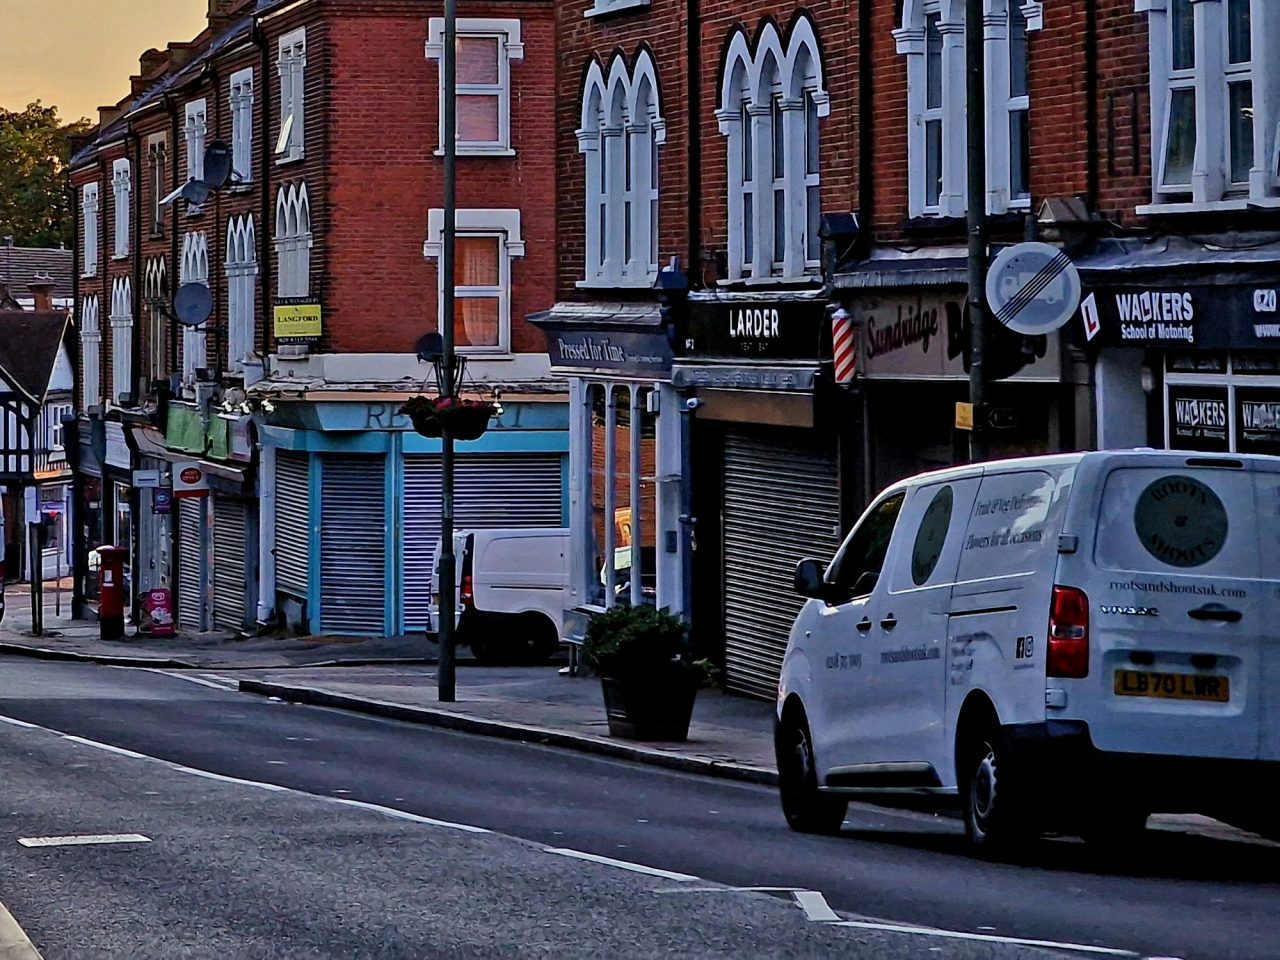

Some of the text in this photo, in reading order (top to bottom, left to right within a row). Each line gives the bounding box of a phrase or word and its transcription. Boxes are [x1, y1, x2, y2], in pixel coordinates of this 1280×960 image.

[1116, 291, 1194, 322] WALKERS
[729, 309, 779, 338] LARDER
[868, 302, 938, 359] Sundridge
[1121, 324, 1147, 339] School
[1158, 323, 1194, 343] Motoring
[558, 338, 589, 360] Pressed
[588, 338, 602, 360] for
[601, 339, 625, 362] Time
[1175, 400, 1225, 427] WALKERS
[1110, 581, 1247, 598] rootsandshootsuk.com
